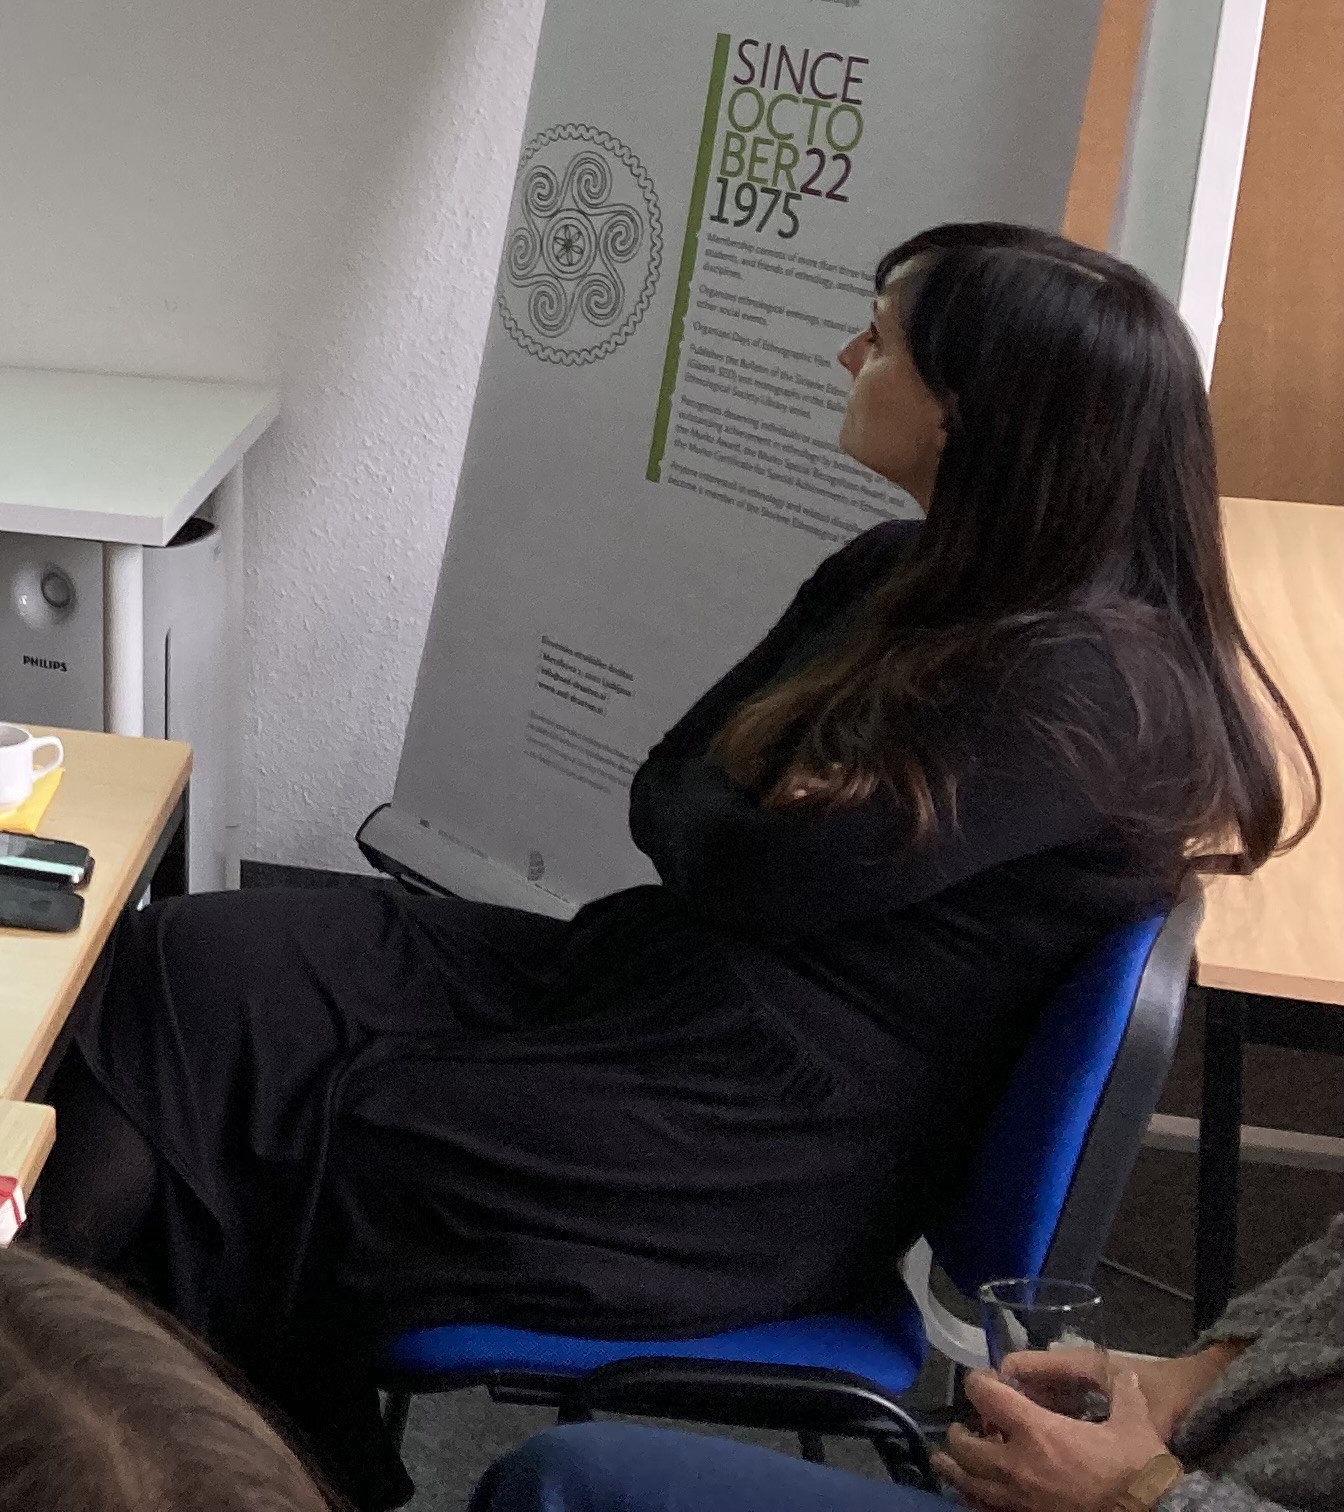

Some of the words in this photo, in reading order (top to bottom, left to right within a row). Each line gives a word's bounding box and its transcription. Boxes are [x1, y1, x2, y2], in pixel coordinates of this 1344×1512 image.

[733, 38, 869, 105] SINCE
[727, 86, 864, 152] OCTO
[709, 177, 803, 240] 1975
[23, 654, 67, 672] PHILIPS
